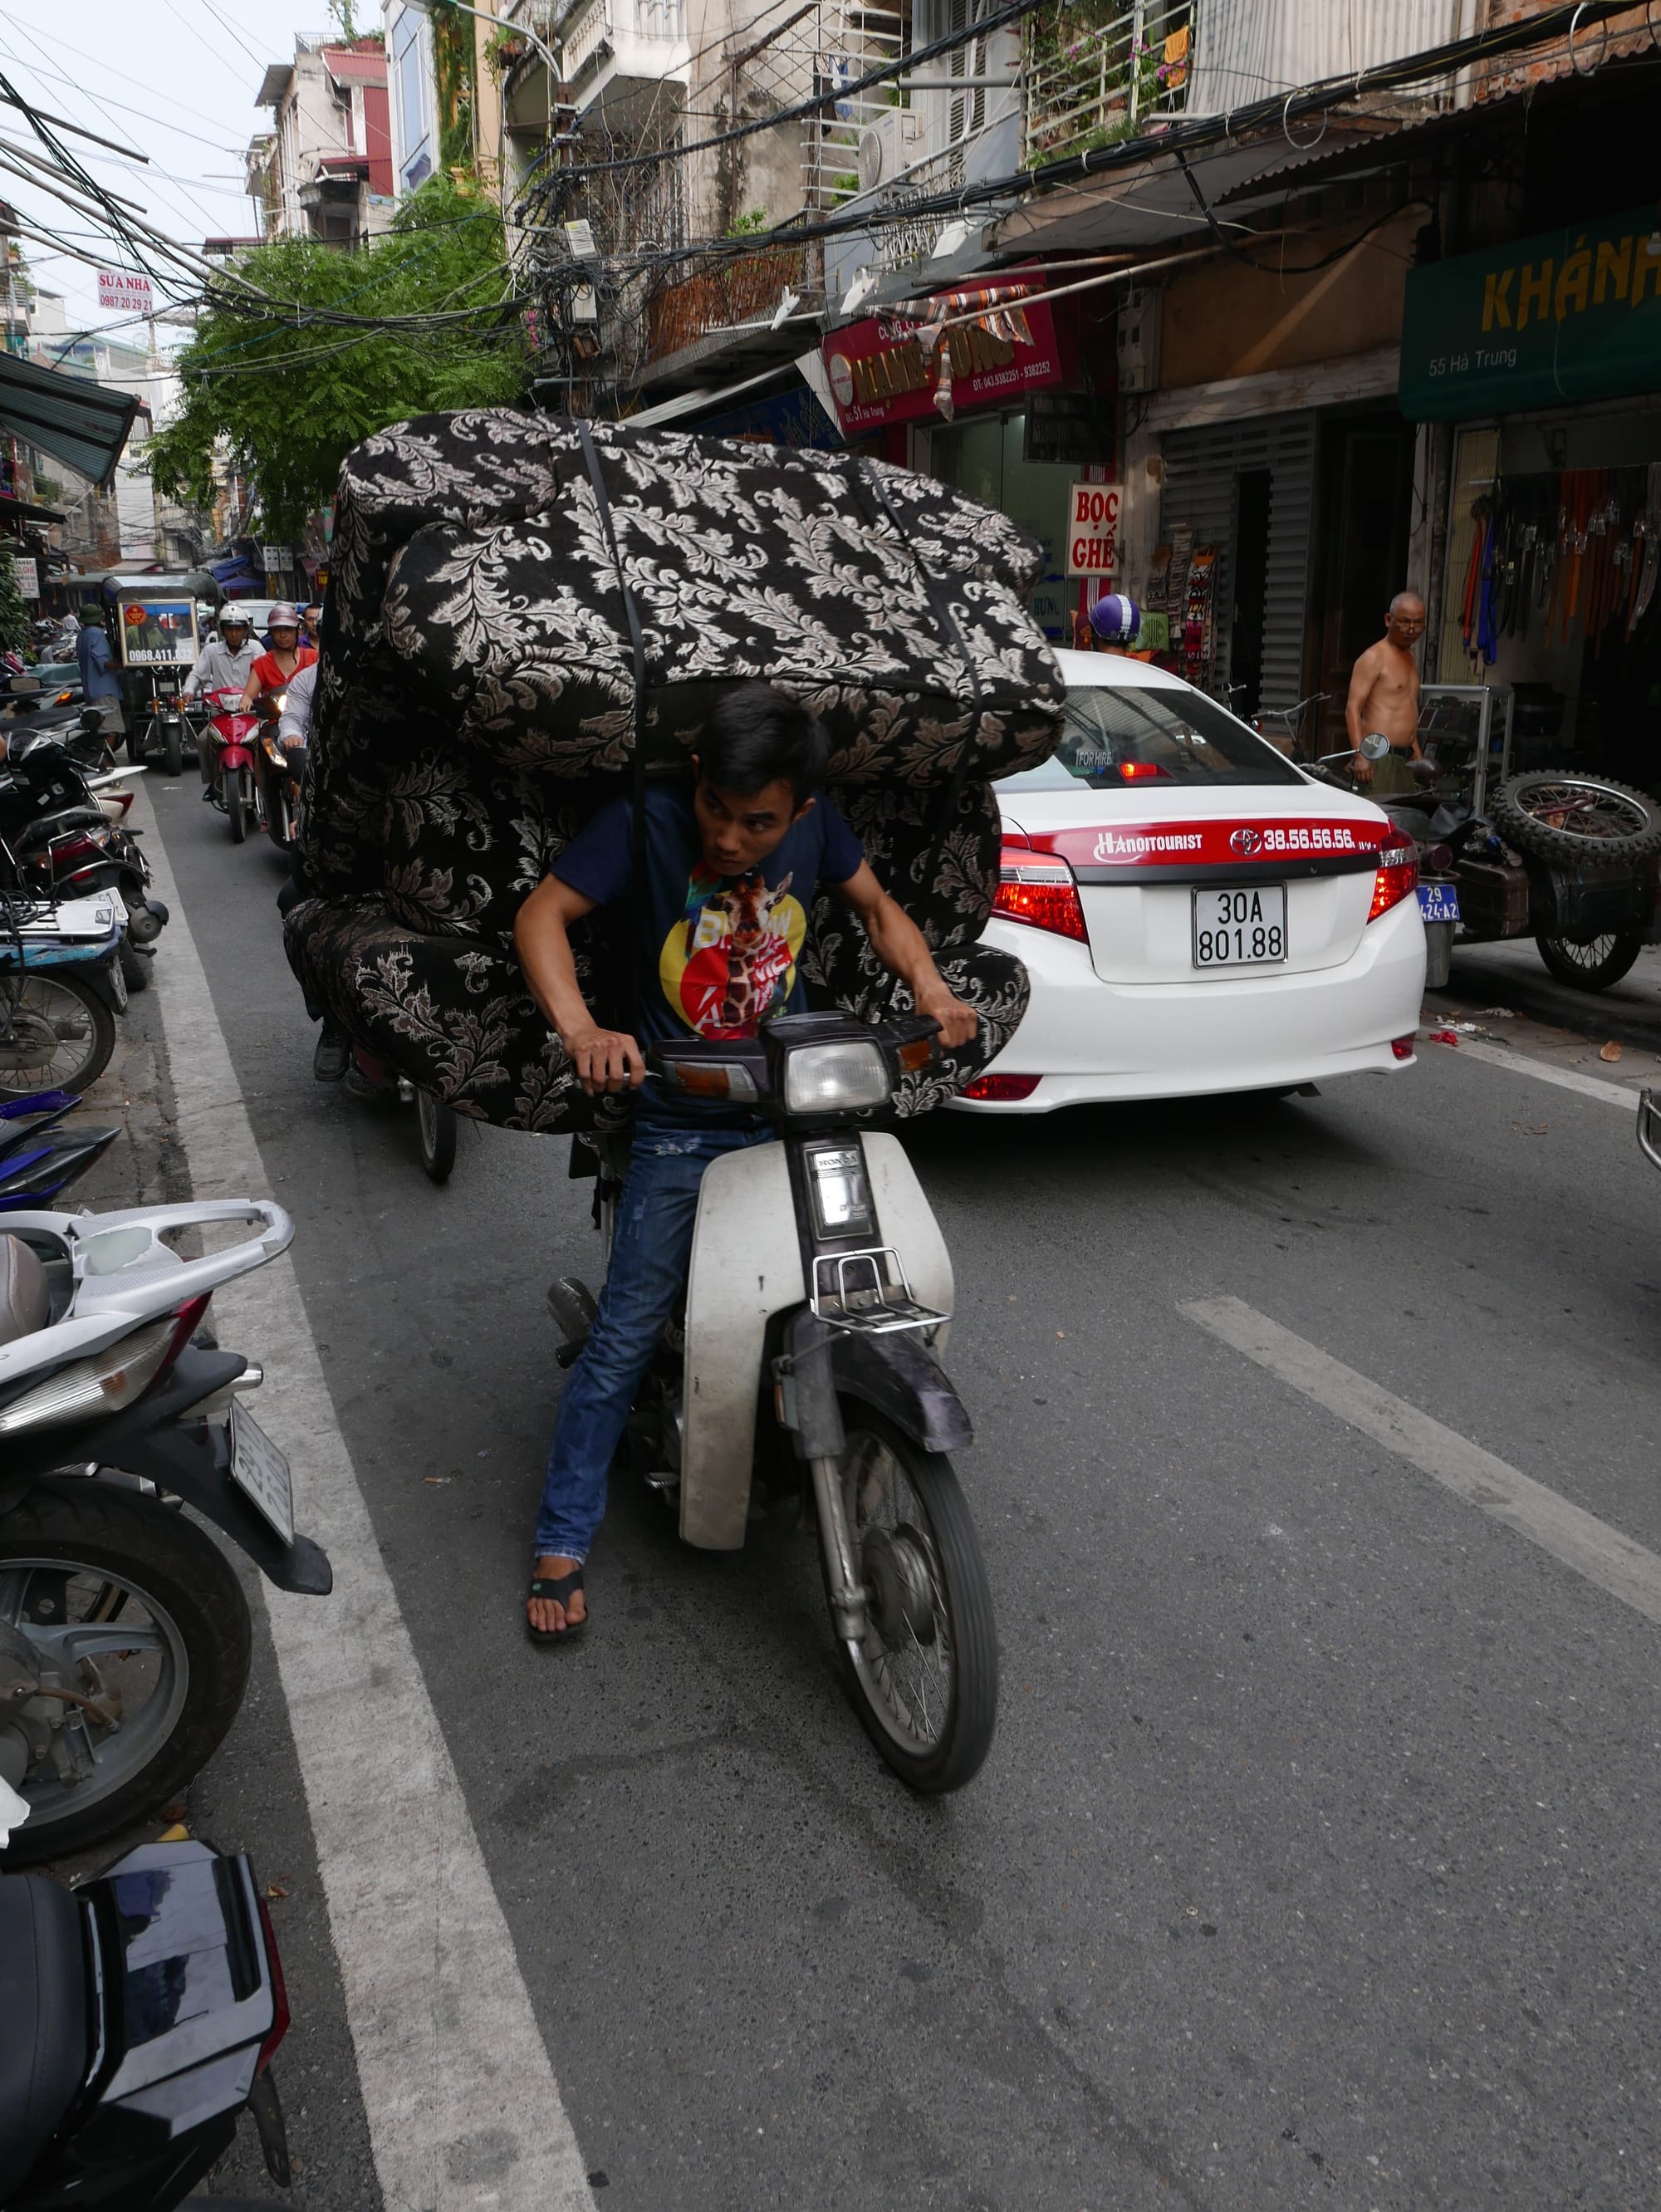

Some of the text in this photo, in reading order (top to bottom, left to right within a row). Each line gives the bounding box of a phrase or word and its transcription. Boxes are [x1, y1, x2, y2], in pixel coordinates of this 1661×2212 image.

[126, 275, 150, 292] NHÀ
[100, 294, 152, 311] 0987 20 29 21
[1024, 360, 1051, 378] 9382252
[1429, 348, 1516, 377] 55 Hà Trung
[853, 405, 863, 421] 51
[1076, 492, 1119, 530] BỌC
[1072, 524, 1117, 568] GHẾ
[1080, 750, 1112, 766] FOR HIRE
[1427, 887, 1443, 903] 29
[1217, 890, 1263, 925] 30A
[1198, 926, 1282, 962] 801.88
